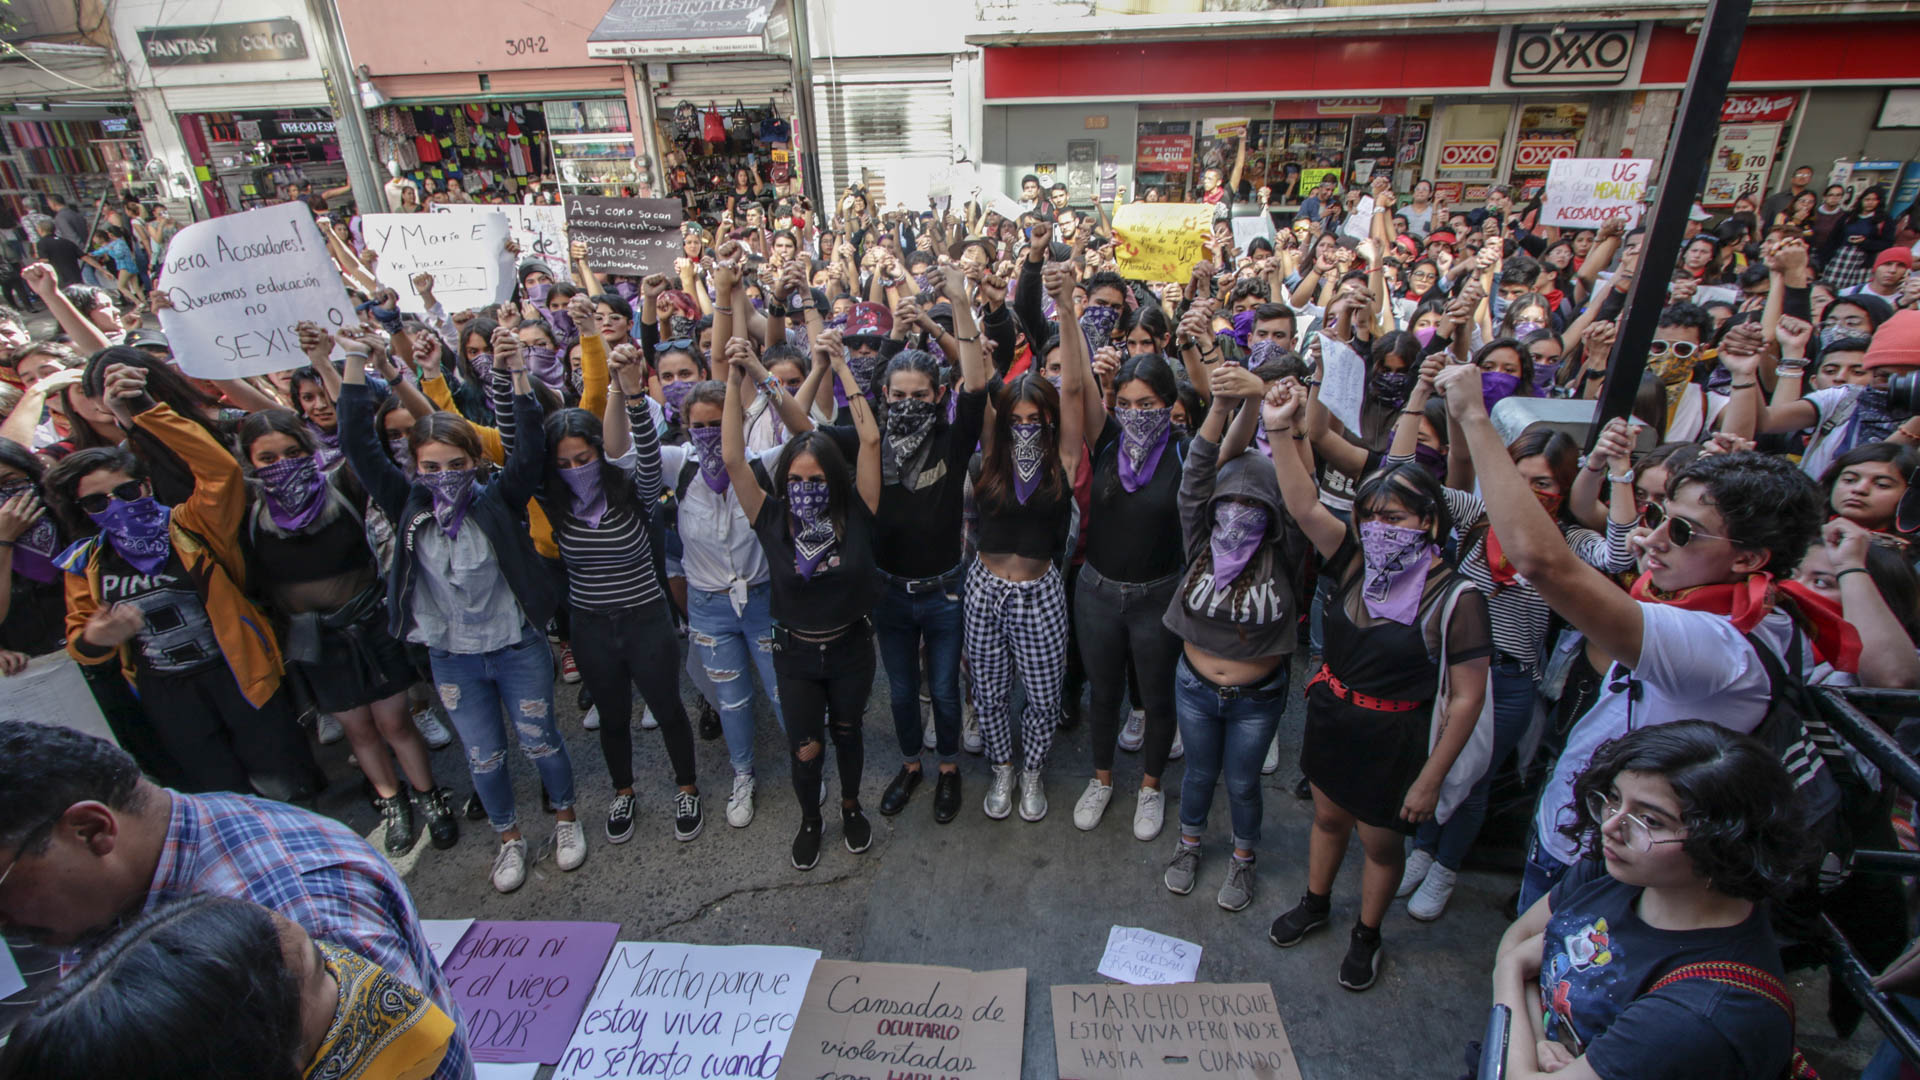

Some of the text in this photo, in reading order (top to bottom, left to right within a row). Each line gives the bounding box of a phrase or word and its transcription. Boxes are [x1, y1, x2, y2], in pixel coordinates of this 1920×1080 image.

[148, 37, 218, 57] FANTASY
[241, 31, 298, 51] COLOR
[1518, 30, 1628, 74] OXXO
[1443, 145, 1496, 164] OXXO
[1519, 146, 1576, 164] OXXO
[1612, 162, 1640, 181] UG
[1593, 181, 1643, 200] MEDALLAS
[638, 210, 671, 221] sacan
[1556, 205, 1633, 223] ACOSADORES
[375, 224, 392, 252] Y
[532, 231, 559, 256] de
[167, 253, 210, 275] uera
[587, 247, 647, 261] OSADORES
[167, 272, 321, 313] Queremos educación
[433, 272, 470, 288] ADA
[244, 302, 267, 317] no
[215, 307, 344, 362] SEXISO
[1185, 573, 1232, 618] OY
[453, 927, 568, 971] gloria ni
[1161, 939, 1187, 959] UG
[467, 962, 570, 1008] al viejo
[597, 946, 791, 1009] Marcho porque
[827, 975, 1007, 1022] Cansadas de
[1072, 990, 1276, 1020] MARCHO PORQUE
[584, 1000, 796, 1049] estoy viva pero
[876, 1018, 961, 1041] OCULTARLO
[1070, 1020, 1281, 1043] ESTOY VIVA PERO NO SE
[561, 1046, 595, 1077] no
[628, 1040, 693, 1080] hasta
[701, 1040, 783, 1079] cuando
[821, 1040, 977, 1073] violentadas
[1081, 1047, 1282, 1073] HASTA CUANDO
